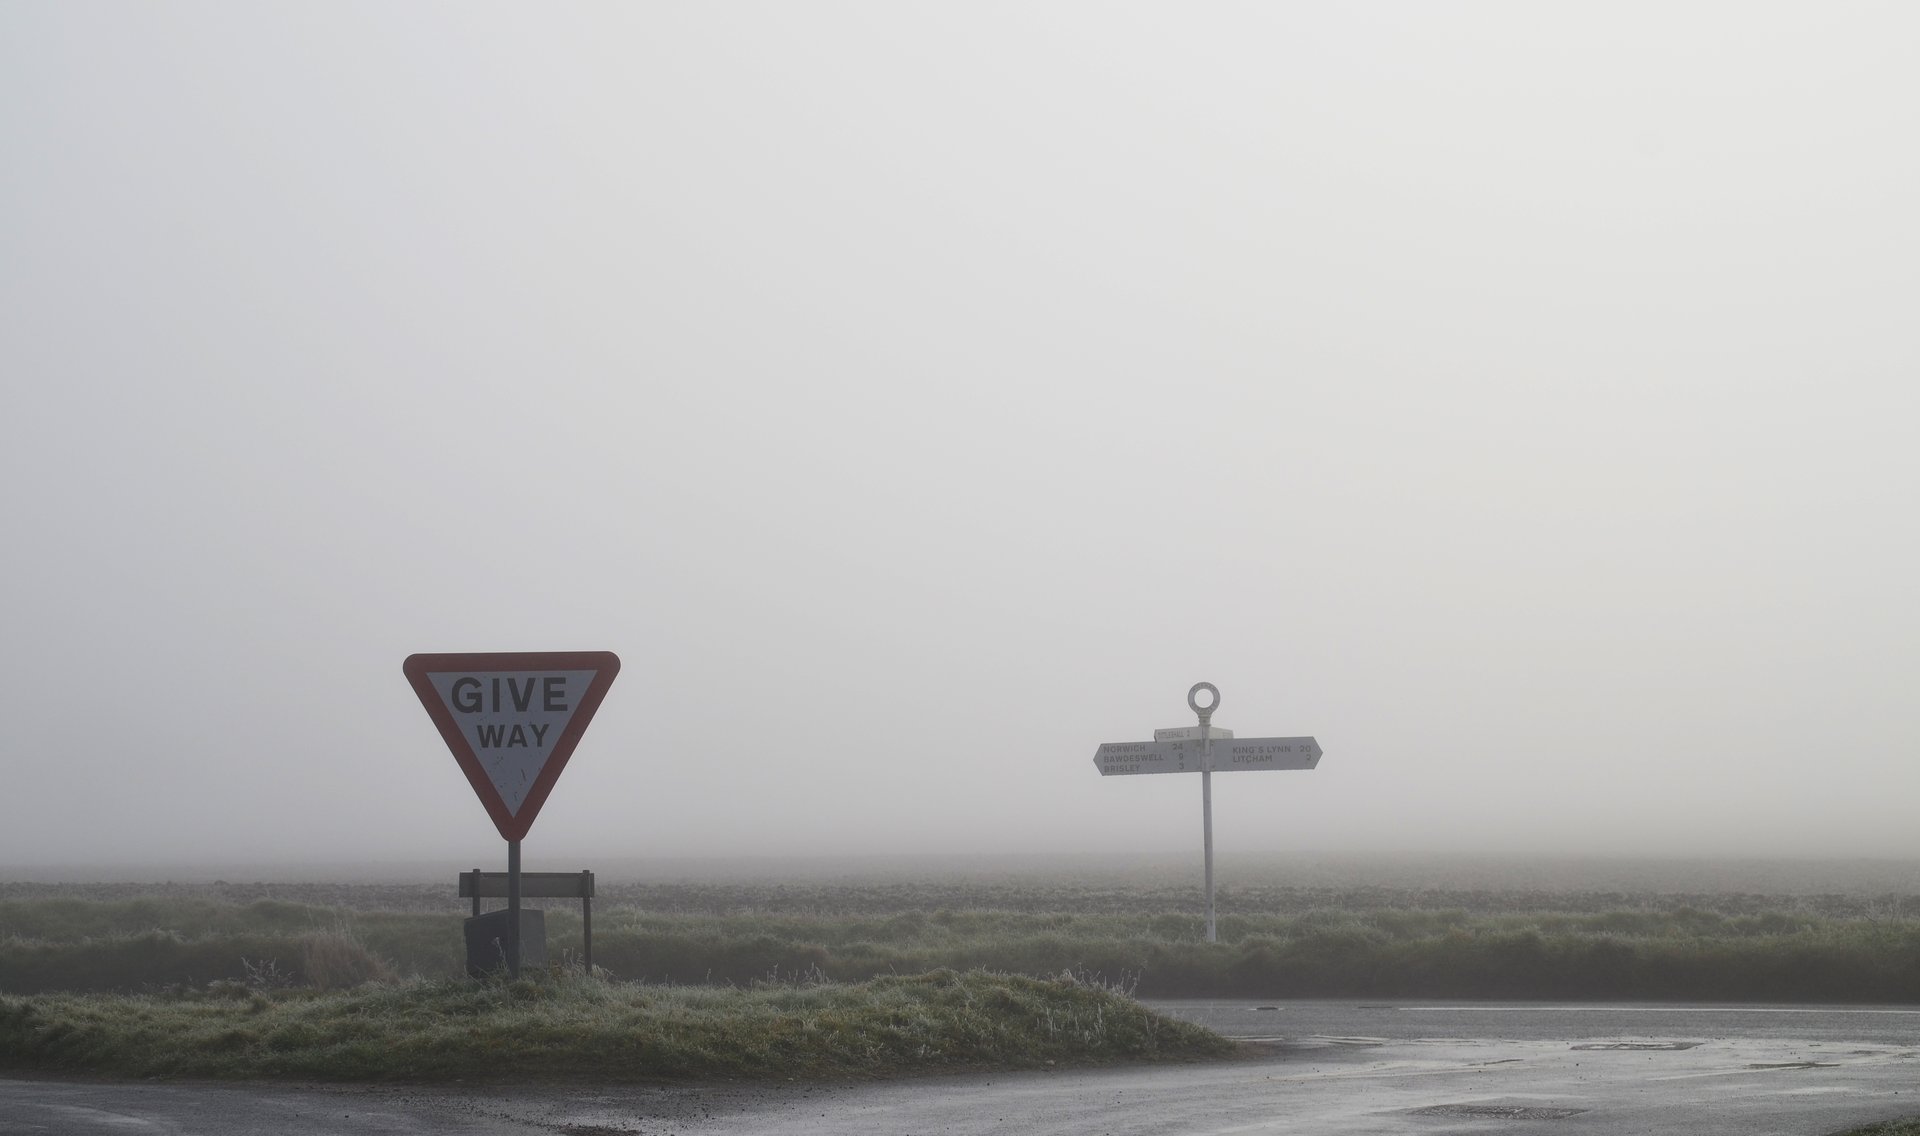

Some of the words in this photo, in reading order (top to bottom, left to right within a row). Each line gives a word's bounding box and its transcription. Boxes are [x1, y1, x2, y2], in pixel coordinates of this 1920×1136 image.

[452, 677, 568, 713] GIVE
[477, 724, 549, 748] WAY
[1103, 744, 1146, 753] NORWICH
[1267, 745, 1291, 753] LYNN
[1299, 745, 1311, 753] 20
[1103, 753, 1164, 763] BAWDESWELL
[1232, 754, 1273, 763] LITCHAM
[1104, 764, 1141, 773] BRISLEY
